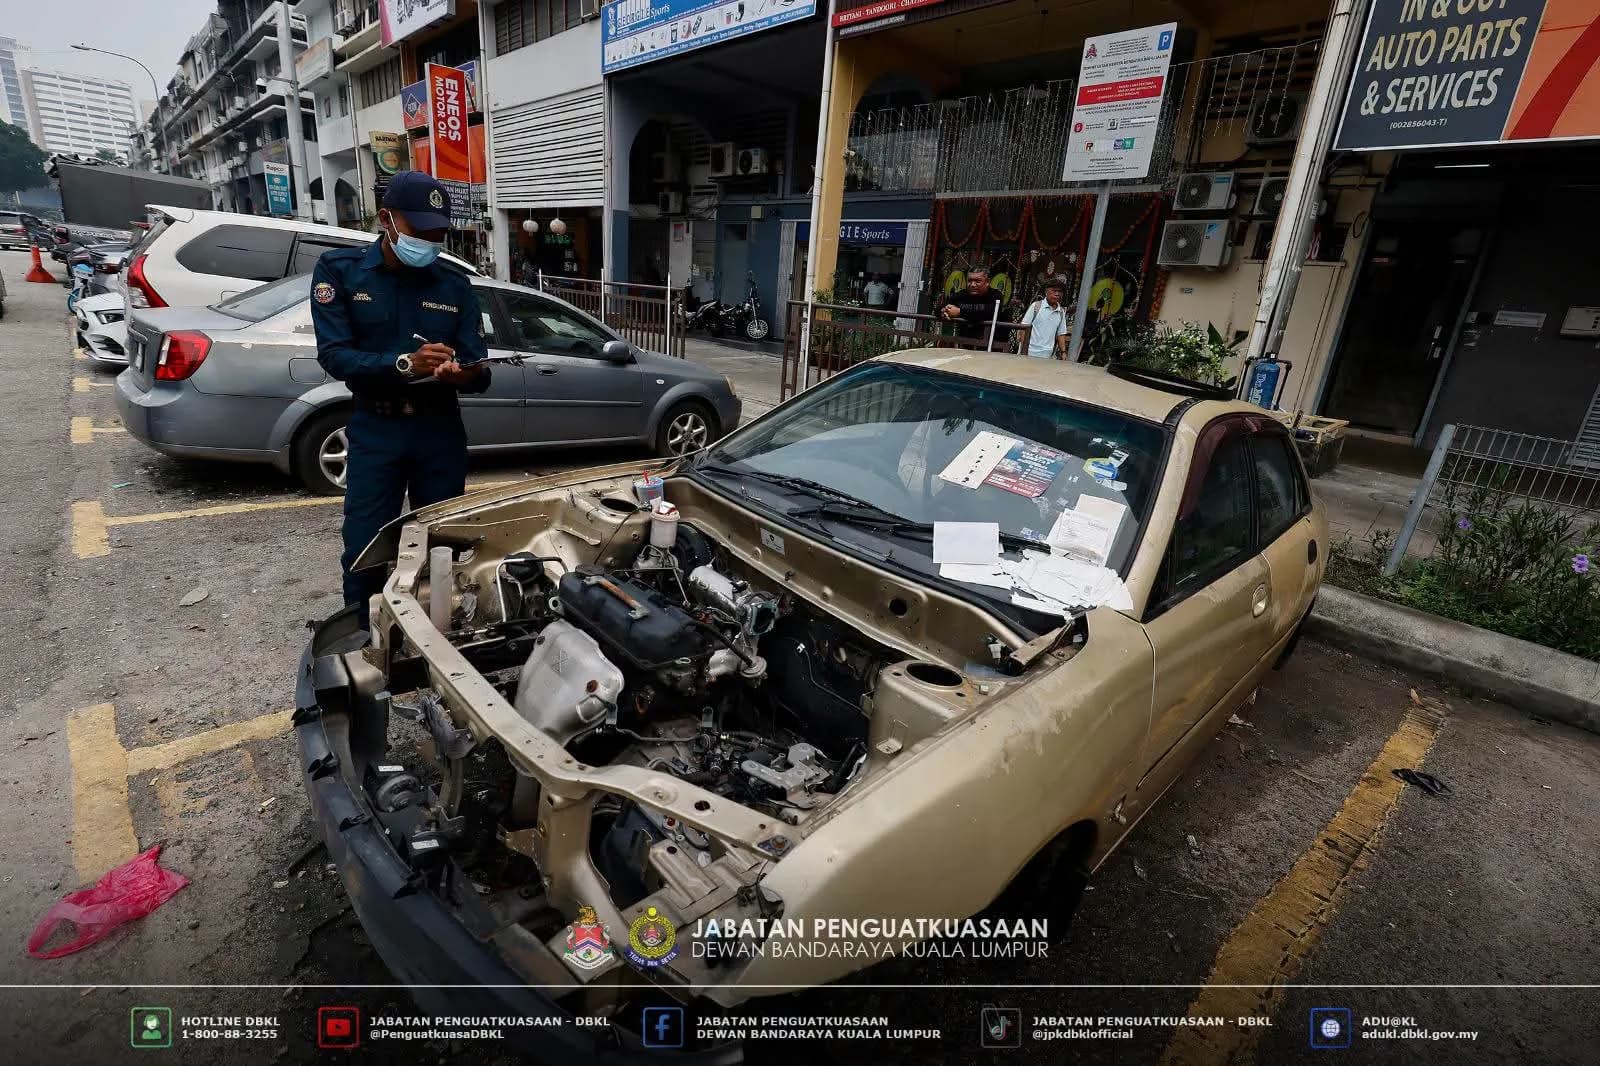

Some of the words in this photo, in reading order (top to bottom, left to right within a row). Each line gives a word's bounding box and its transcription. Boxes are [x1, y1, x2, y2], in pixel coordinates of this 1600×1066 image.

[651, 3, 670, 19] Sports
[1366, 29, 1436, 72] AUTO
[1437, 17, 1528, 64] PARTS
[435, 76, 446, 118] MOTOR
[1360, 80, 1380, 116] &
[1381, 68, 1504, 114] SERVICES
[445, 78, 462, 141] ENEOS
[1390, 118, 1448, 130] (002856043-T)
[438, 121, 447, 139] OIL
[861, 228, 890, 242] Sports
